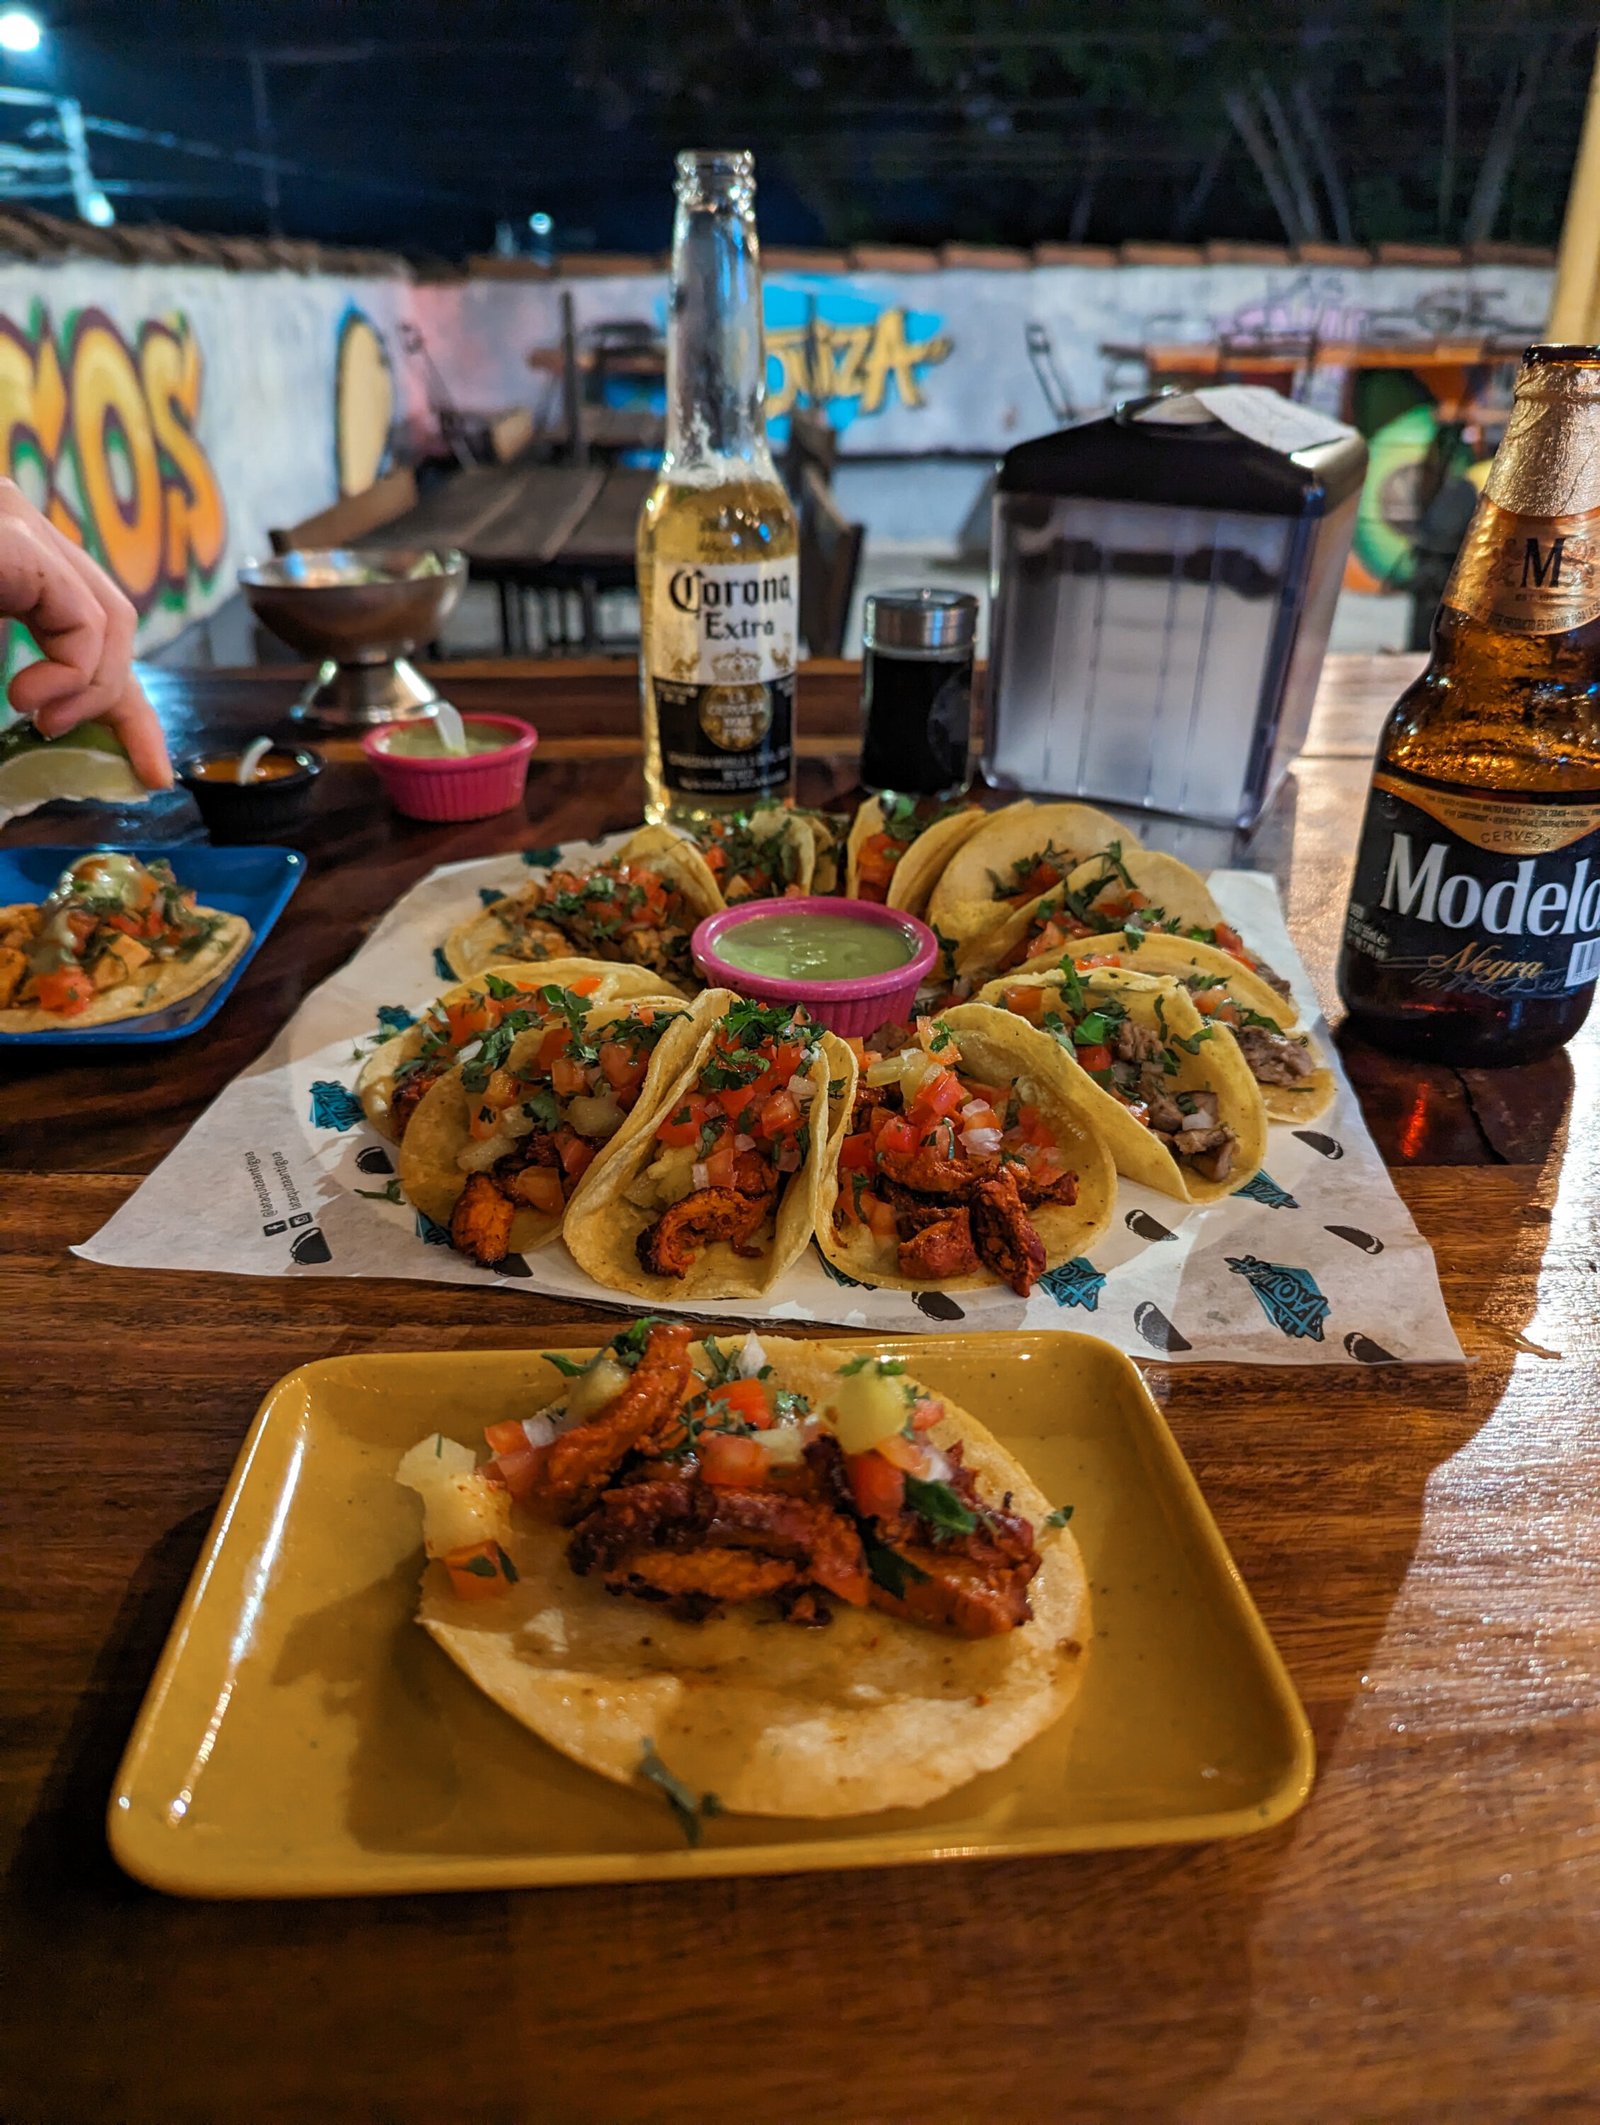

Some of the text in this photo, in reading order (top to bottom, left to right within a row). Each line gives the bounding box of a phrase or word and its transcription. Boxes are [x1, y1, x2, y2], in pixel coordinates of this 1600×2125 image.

[1519, 537, 1567, 589] M
[669, 567, 793, 619] Corona
[704, 611, 775, 640] Extra
[1480, 830, 1551, 849] CERVEZA
[1379, 832, 1600, 936] Modelo
[1428, 941, 1546, 984] Negra
[244, 1151, 278, 1217] @lataquizaantigua
[272, 1151, 302, 1211] lataquizaantigua
